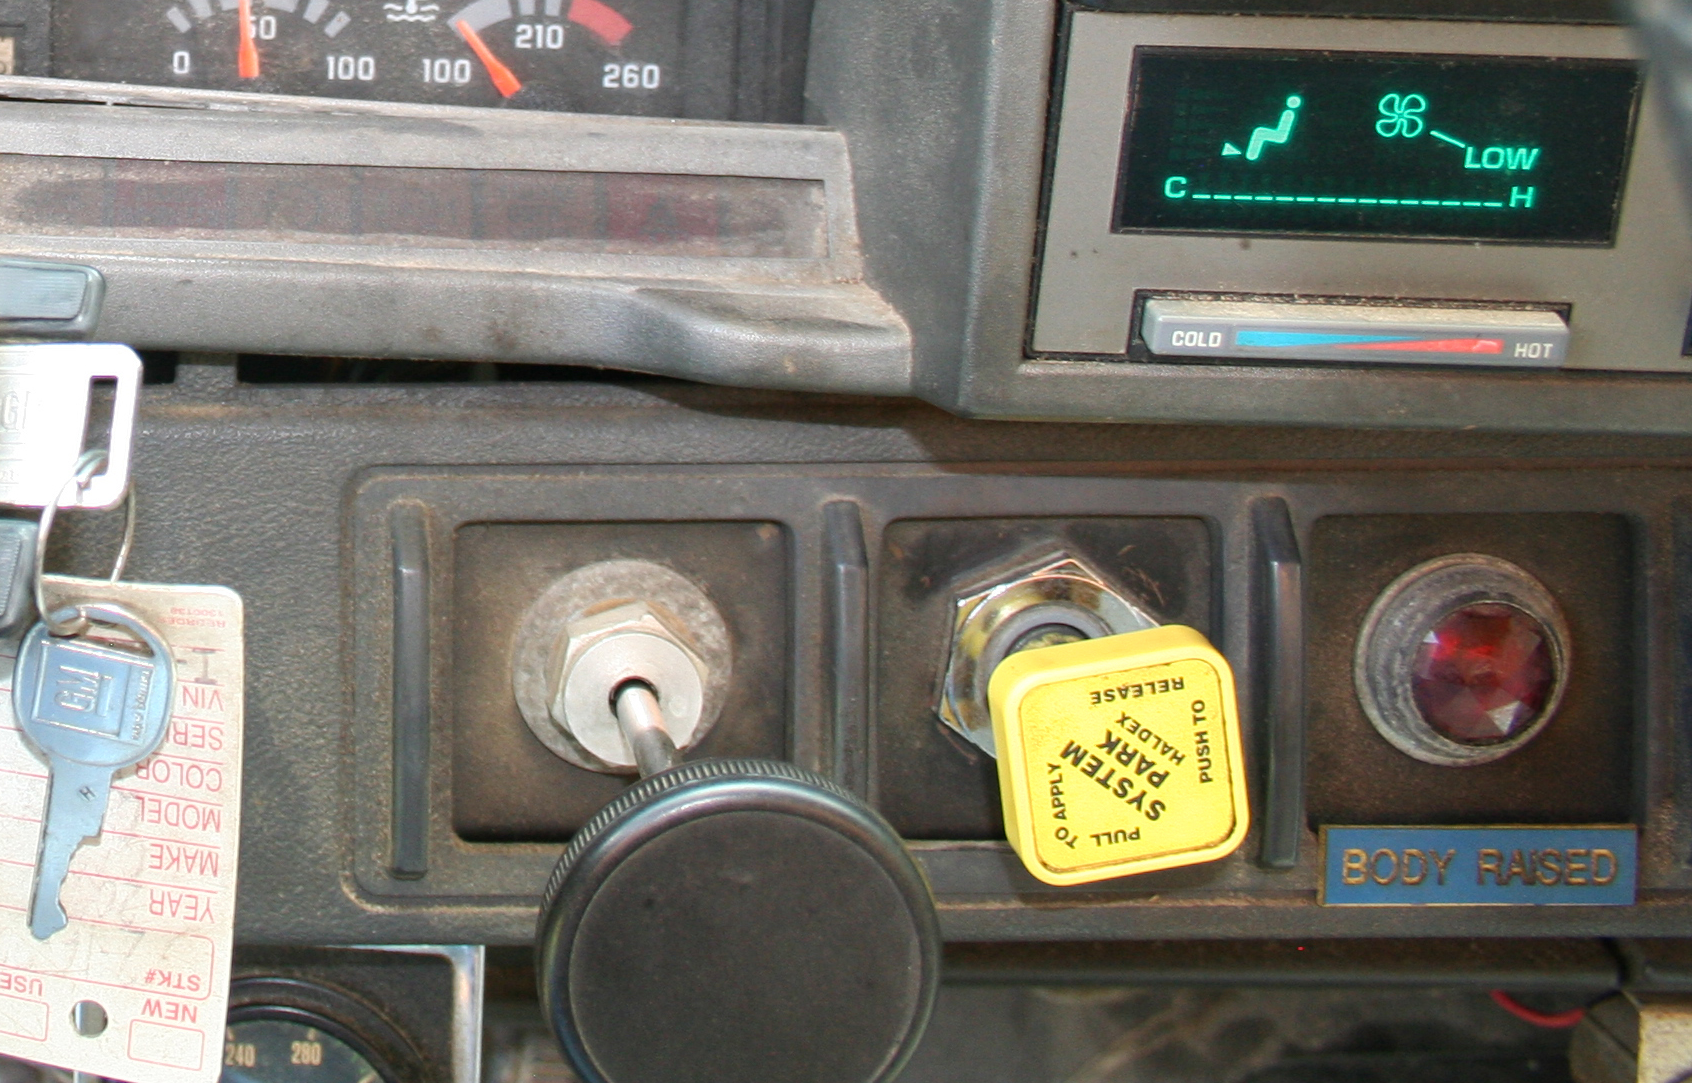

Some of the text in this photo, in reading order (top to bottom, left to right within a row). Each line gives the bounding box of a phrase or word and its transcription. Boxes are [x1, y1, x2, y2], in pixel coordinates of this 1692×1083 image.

[514, 24, 564, 50] 210
[171, 51, 191, 76] 0
[325, 55, 377, 83] 100
[421, 57, 472, 84] 100
[602, 63, 662, 91] 260
[1463, 146, 1543, 172] LOW
[1163, 175, 1188, 201] C
[1508, 185, 1535, 209] H
[1170, 329, 1224, 349] COLD
[1513, 342, 1555, 361] HOT
[53, 664, 101, 713] GM
[181, 684, 225, 713] VIN
[1089, 675, 1186, 706] RELEASE
[164, 721, 224, 751] SERI
[1114, 710, 1187, 767] HALDEX
[1190, 698, 1215, 785] PUSH TO
[1095, 728, 1172, 790] PARK
[135, 757, 224, 793] COLOR
[1058, 738, 1168, 822] SYSTEM
[135, 794, 222, 834] MODEL
[1046, 761, 1142, 850] PULL TO APPLY
[147, 842, 219, 878] MAKE
[1341, 847, 1620, 887] BODY RAISED
[148, 888, 216, 925] YEAR
[144, 967, 202, 992] STK#
[140, 997, 198, 1024] NEW
[224, 1043, 257, 1068] 240
